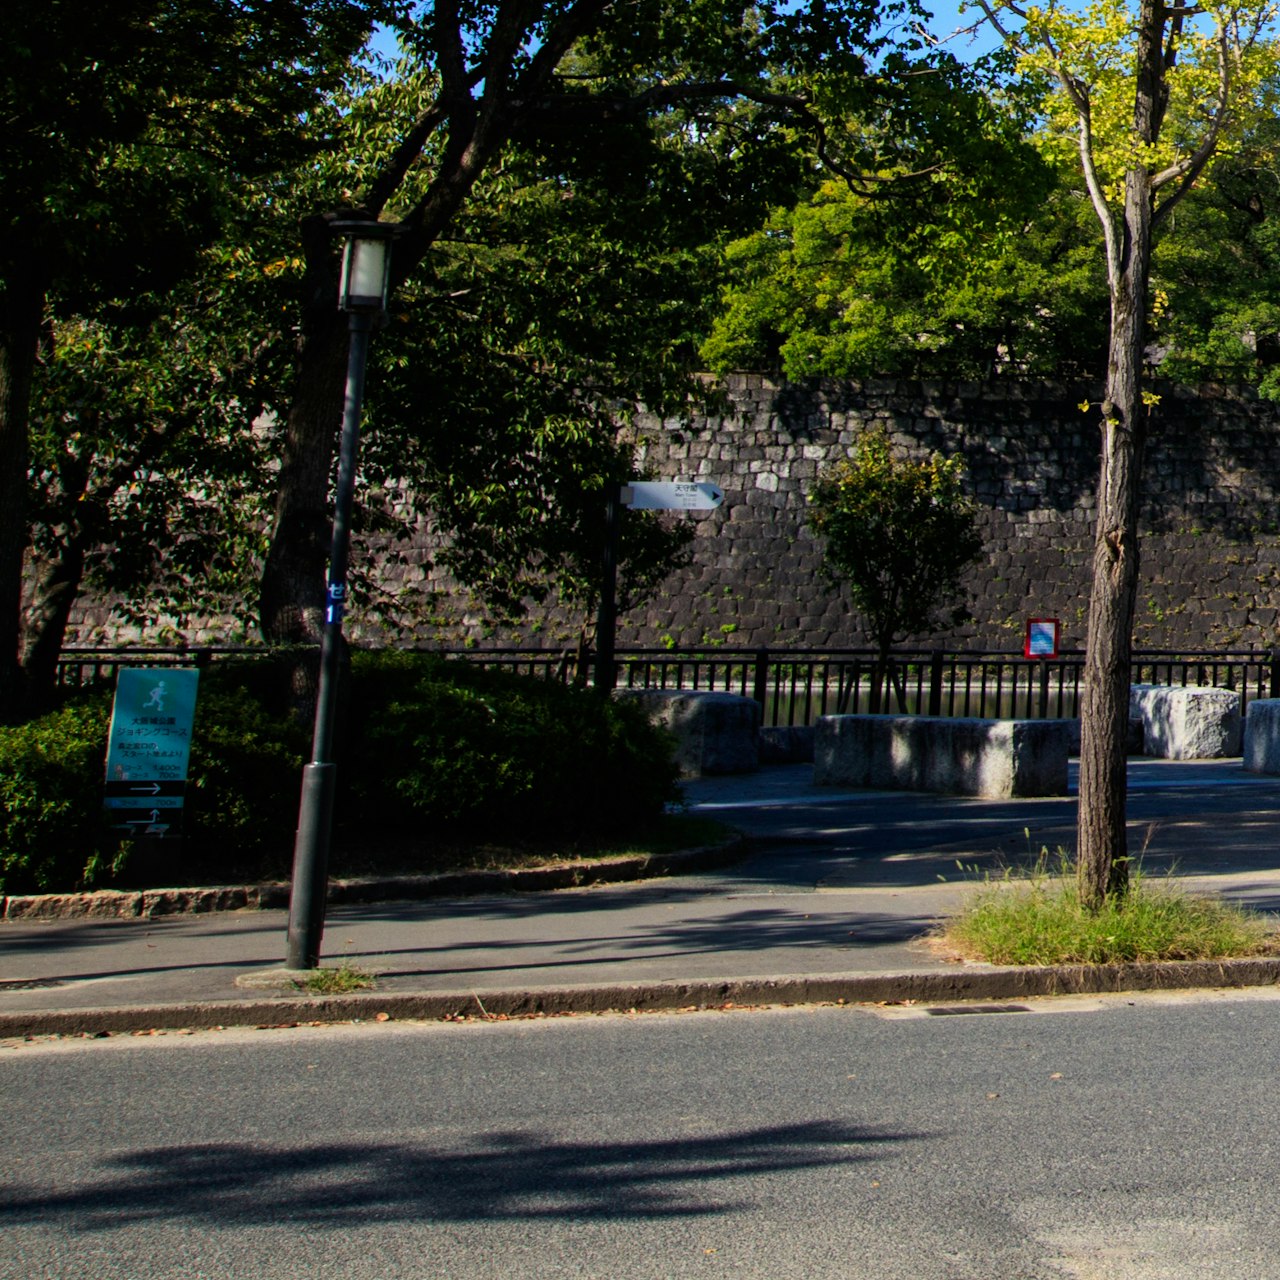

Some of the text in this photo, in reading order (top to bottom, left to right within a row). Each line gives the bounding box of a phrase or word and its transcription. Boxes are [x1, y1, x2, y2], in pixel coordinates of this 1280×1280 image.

[329, 583, 345, 599] せ
[131, 717, 176, 725] 大阪城公園
[117, 727, 188, 737] ジョギングコース
